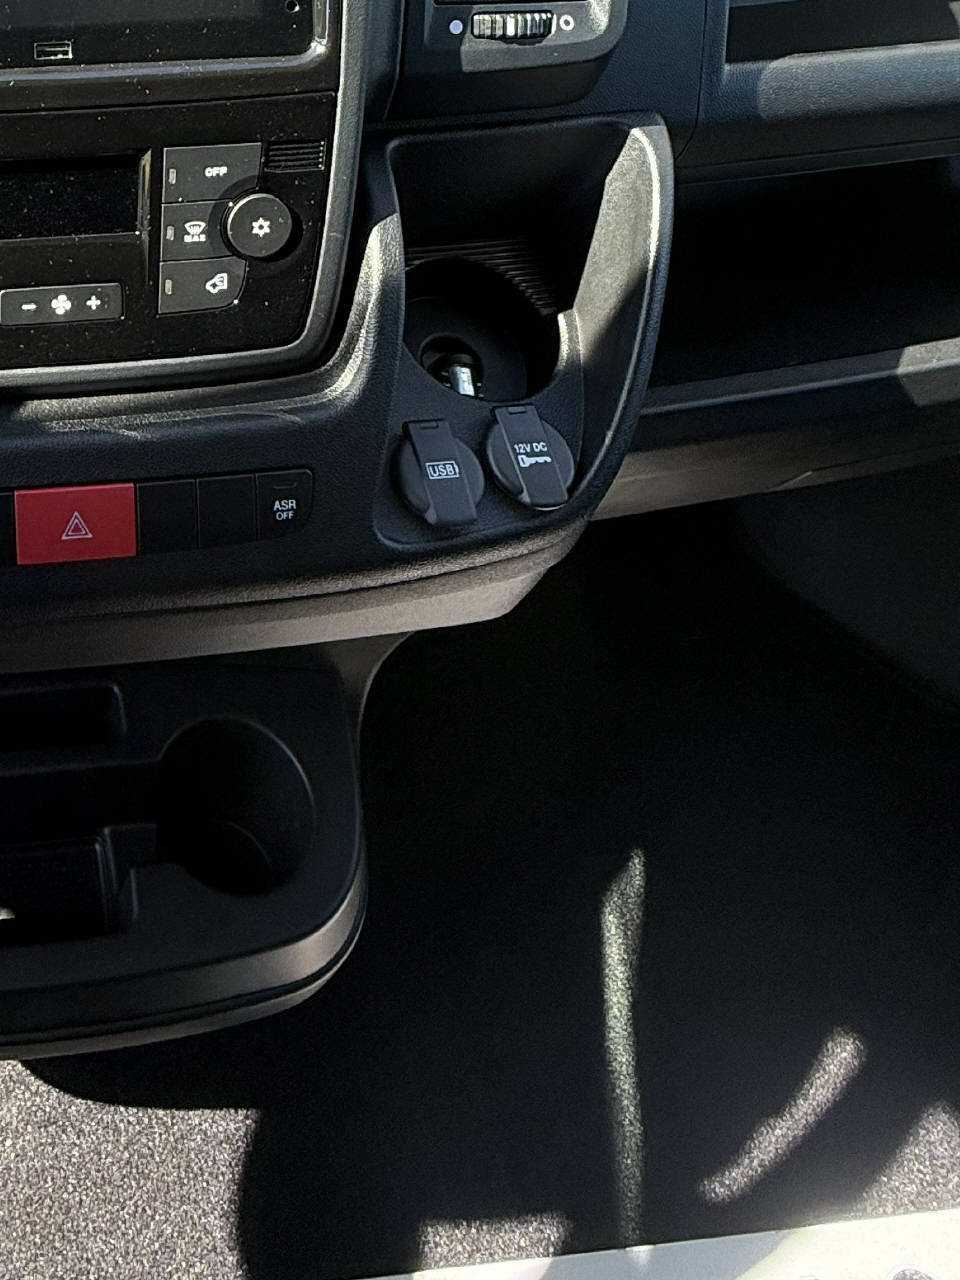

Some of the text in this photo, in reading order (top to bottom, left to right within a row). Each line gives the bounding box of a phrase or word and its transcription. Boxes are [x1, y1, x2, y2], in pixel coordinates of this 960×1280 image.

[204, 165, 228, 177] OFF
[514, 441, 548, 453] 12V DC
[428, 463, 456, 477] USB
[273, 499, 297, 511] ASR
[276, 510, 295, 521] OFF
